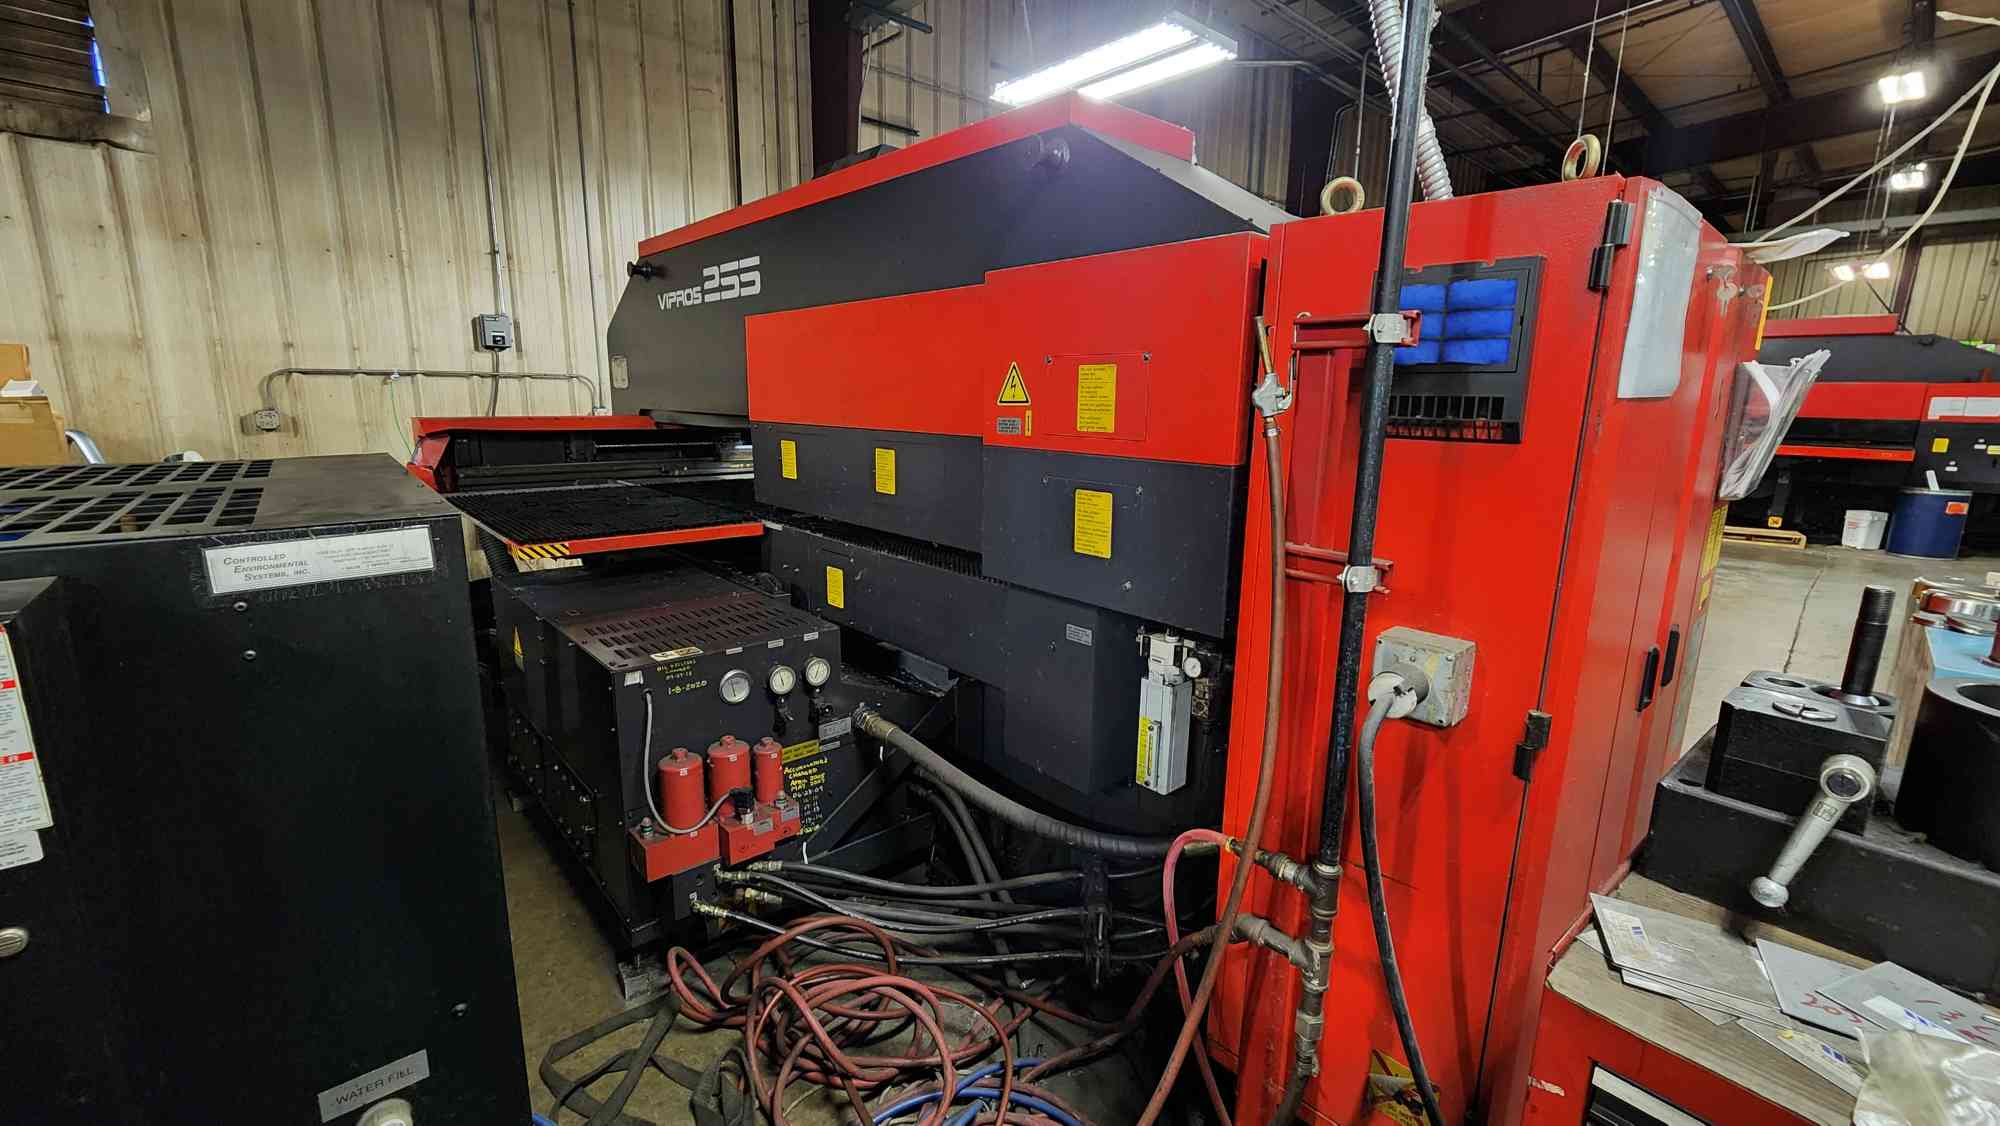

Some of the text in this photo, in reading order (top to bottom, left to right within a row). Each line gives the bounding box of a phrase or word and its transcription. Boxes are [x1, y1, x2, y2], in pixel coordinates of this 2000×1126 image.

[657, 256, 761, 311] VIPROS 255
[223, 552, 287, 566] CONTROLLED
[335, 1066, 416, 1105] WATER FILL
